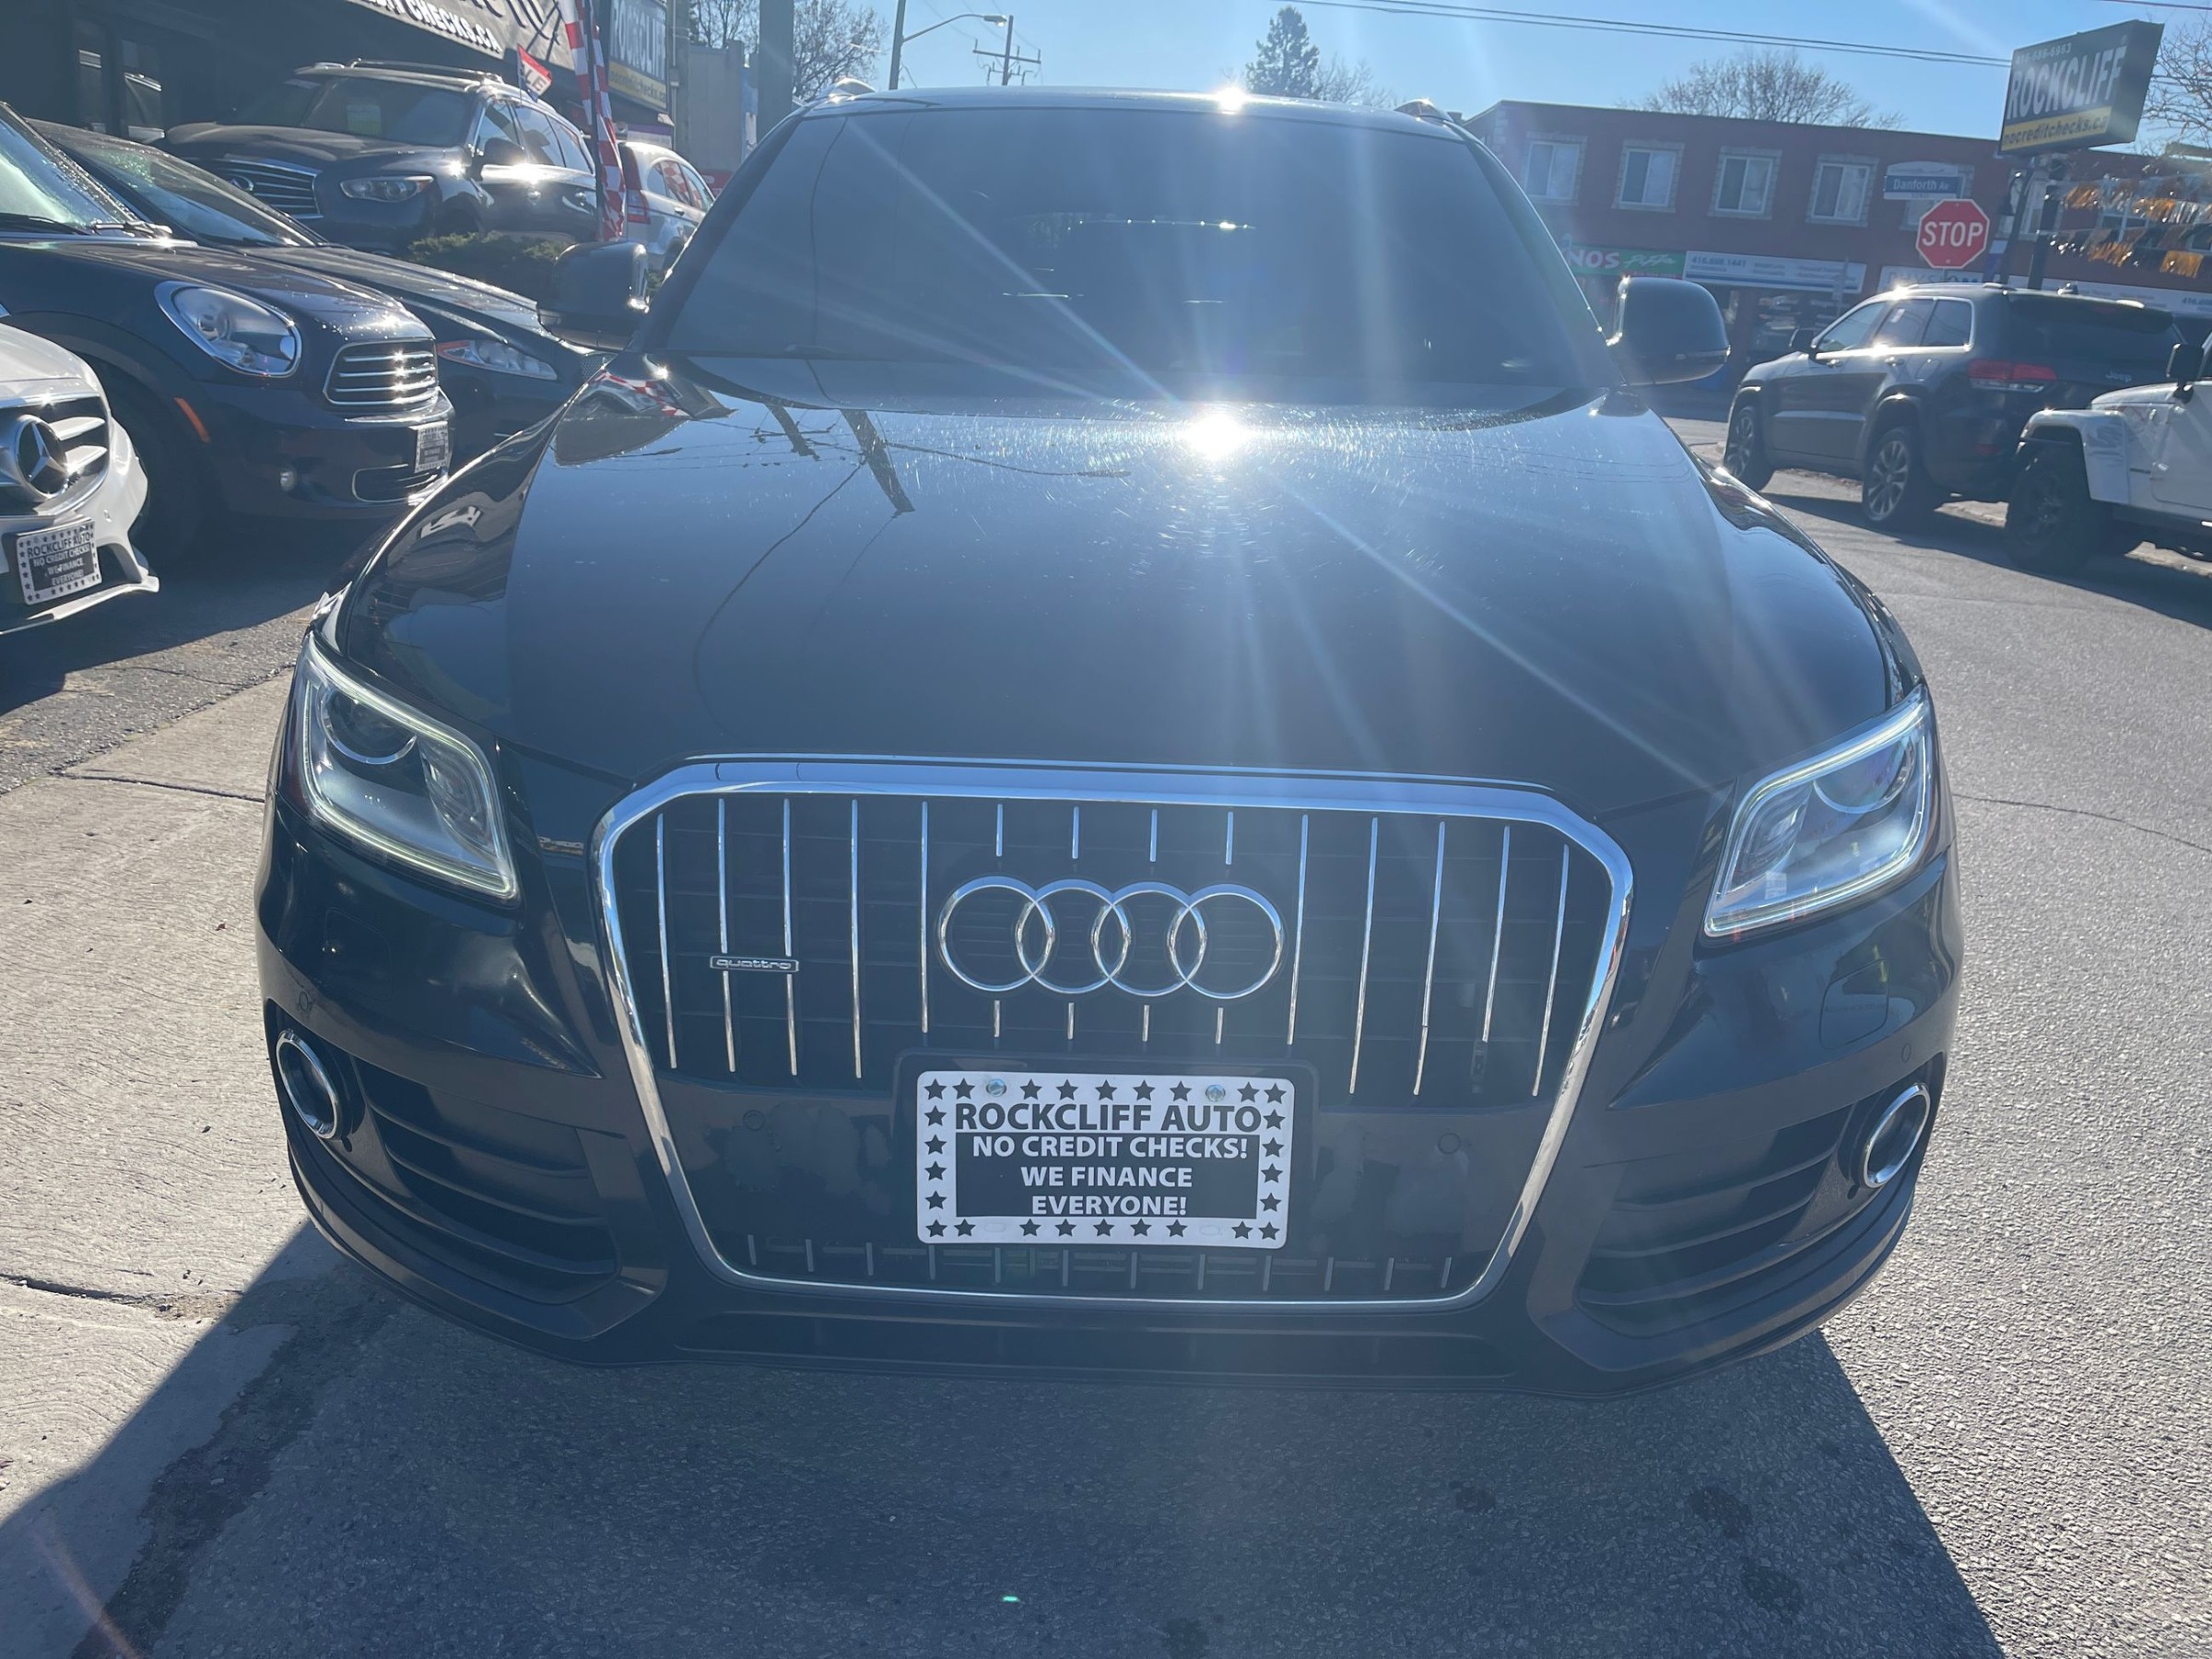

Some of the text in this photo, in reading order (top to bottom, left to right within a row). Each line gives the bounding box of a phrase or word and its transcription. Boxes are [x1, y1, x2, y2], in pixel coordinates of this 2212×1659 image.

[2006, 45, 2127, 120] ROCKCLIFF
[1893, 178, 1937, 191] Danforth
[1922, 221, 1983, 248] STOP
[27, 538, 72, 558] ROCKCLIFF
[716, 959, 792, 970] quattro
[955, 1102, 1263, 1133] ROCKCLIFF AUTO
[972, 1135, 1248, 1159] NO CREDIT CHECKS!
[1020, 1166, 1193, 1188] WE FINANCE
[1032, 1195, 1188, 1217] EVERYONE!
